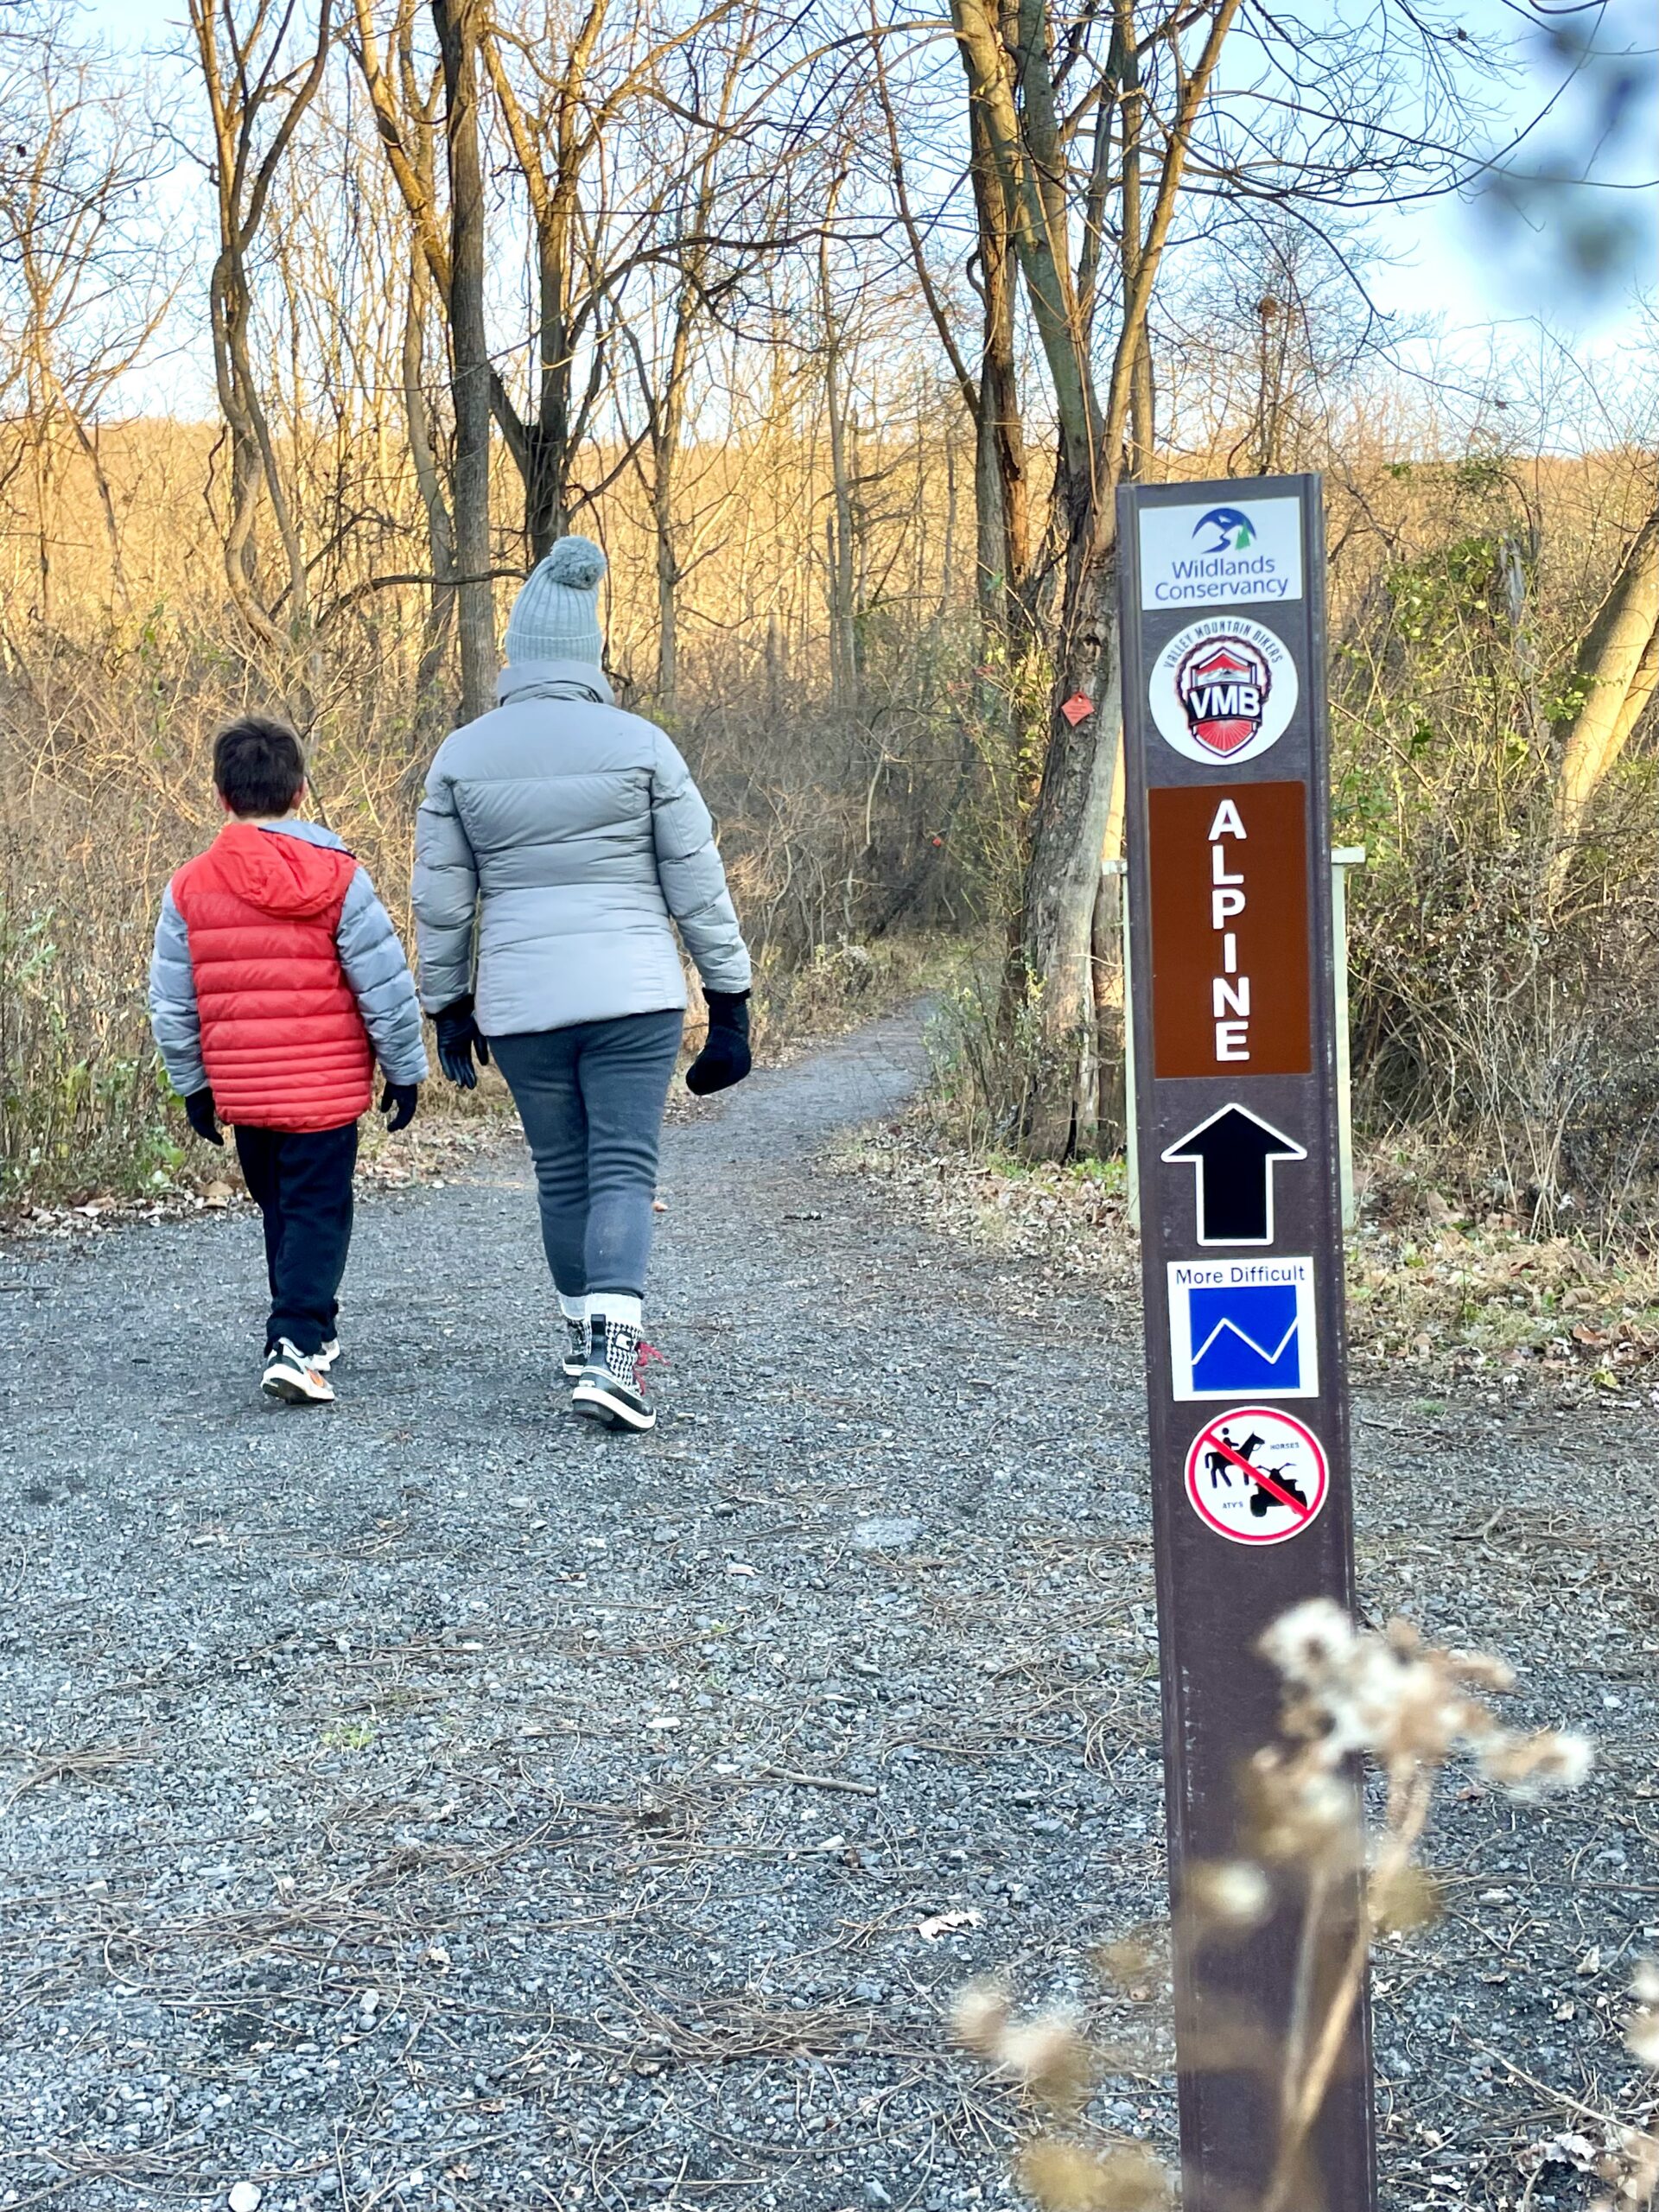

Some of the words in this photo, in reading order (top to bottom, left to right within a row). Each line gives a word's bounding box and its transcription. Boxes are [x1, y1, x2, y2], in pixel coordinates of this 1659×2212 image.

[1172, 556, 1275, 579] Wildlands
[1155, 577, 1288, 601] Conservancy
[1163, 633, 1194, 668] VALLEY
[1194, 620, 1252, 639] MOUNTAIN
[1253, 630, 1283, 664] BIKERS
[1189, 684, 1261, 719] VMB
[1208, 798, 1250, 1062] ALPINE
[1176, 1268, 1224, 1285] More
[1230, 1265, 1305, 1282] Difficult
